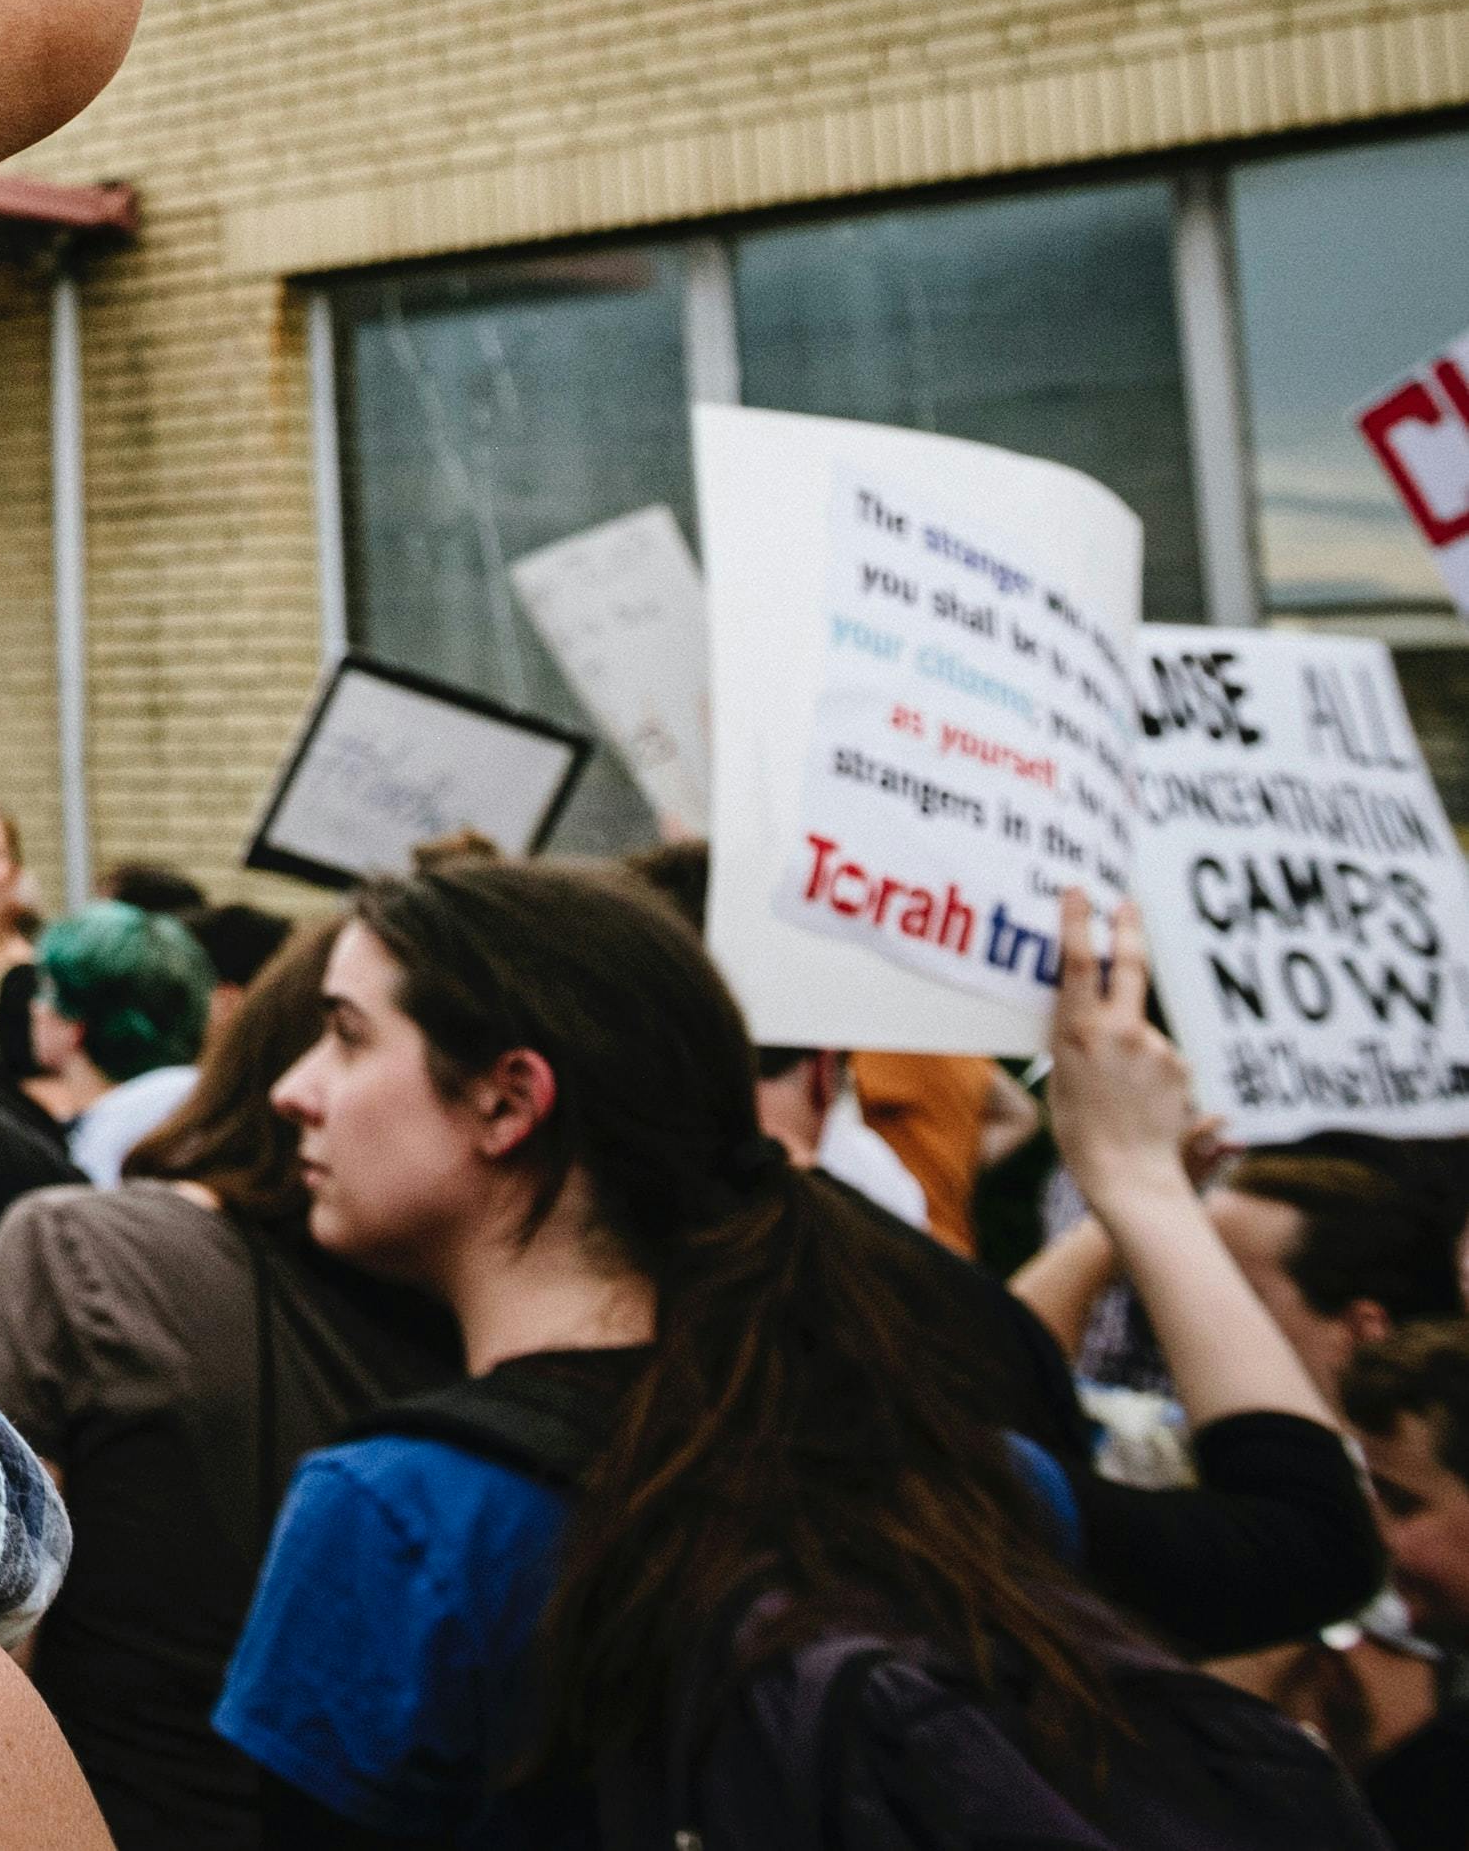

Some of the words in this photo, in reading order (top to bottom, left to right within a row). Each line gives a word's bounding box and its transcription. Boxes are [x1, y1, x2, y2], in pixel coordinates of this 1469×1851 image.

[856, 488, 908, 538] The
[1302, 661, 1417, 773] ALL
[832, 747, 986, 827] strangers
[804, 831, 977, 957] Torah
[1190, 854, 1444, 959] CAMPS
